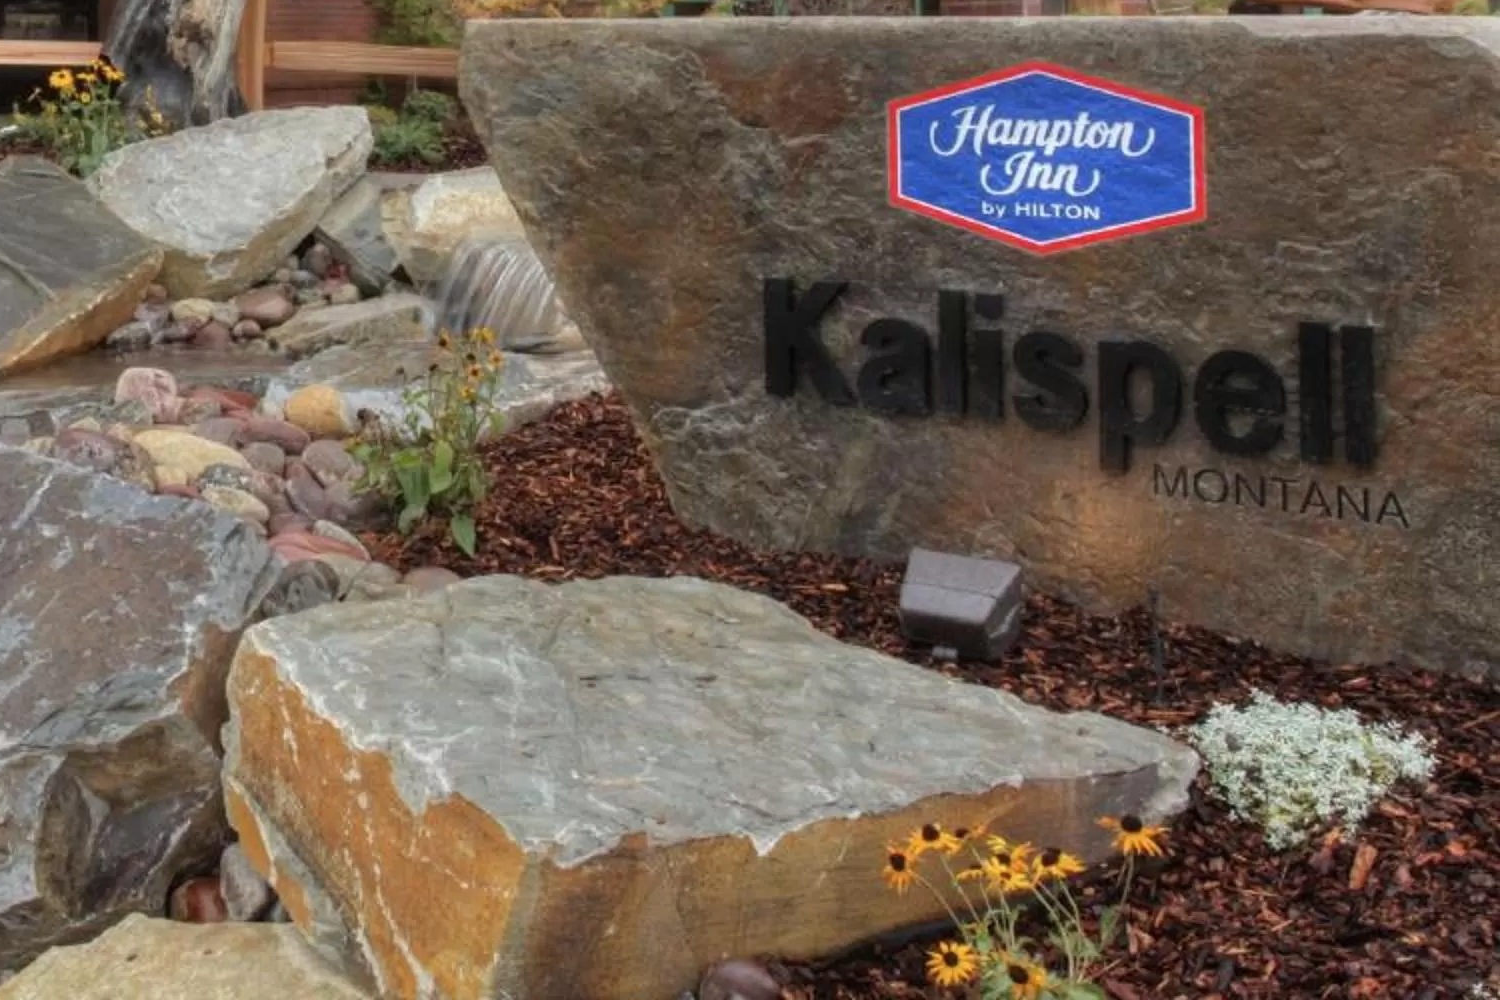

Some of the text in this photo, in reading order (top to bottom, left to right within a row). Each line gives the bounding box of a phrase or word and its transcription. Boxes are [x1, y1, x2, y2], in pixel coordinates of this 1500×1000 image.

[929, 104, 1156, 157] Hampton
[980, 151, 1100, 197] Inn
[981, 200, 1101, 220] by HILTON
[762, 277, 1379, 475] Kalispell
[1152, 462, 1411, 529] MONTANA
